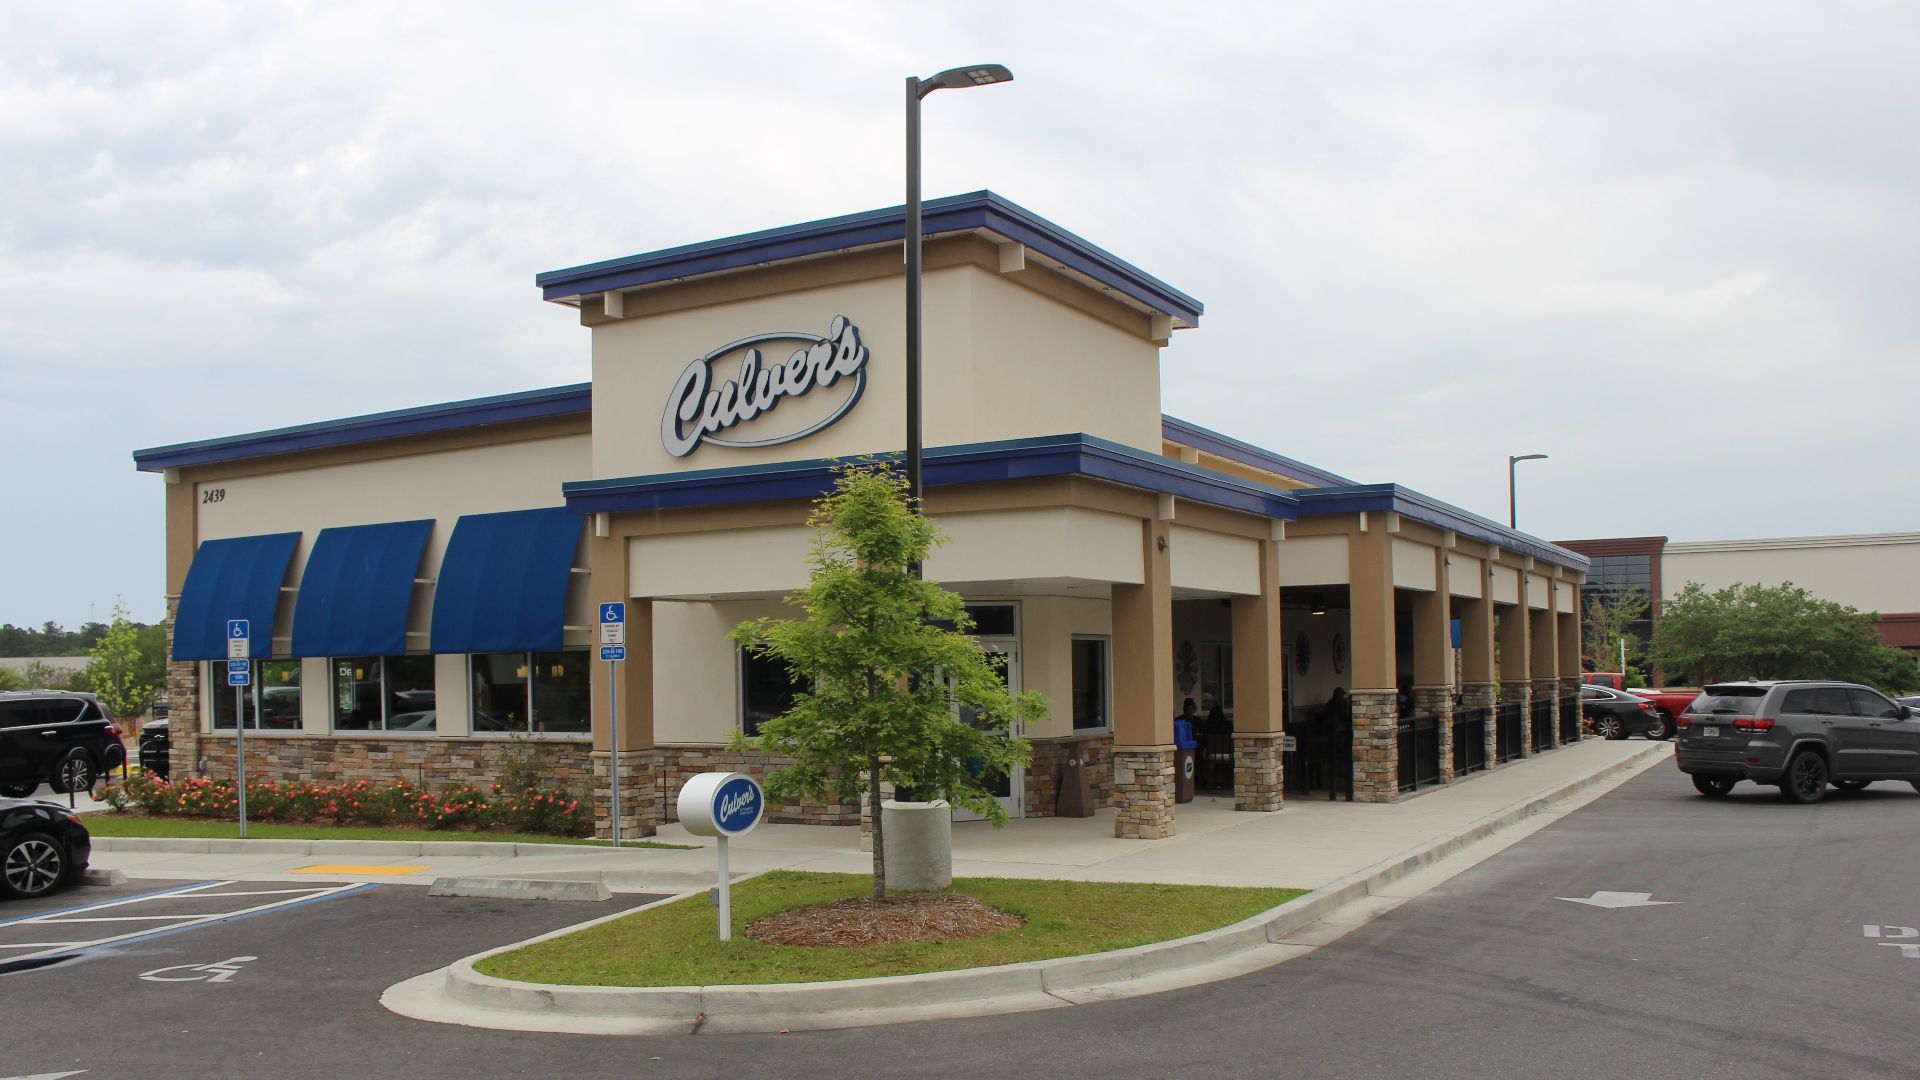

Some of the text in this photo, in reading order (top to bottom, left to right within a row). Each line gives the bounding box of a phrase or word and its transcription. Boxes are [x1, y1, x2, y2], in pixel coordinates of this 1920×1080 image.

[660, 314, 869, 459] Culver's
[202, 488, 226, 504] 2439
[719, 784, 755, 823] Culver's
